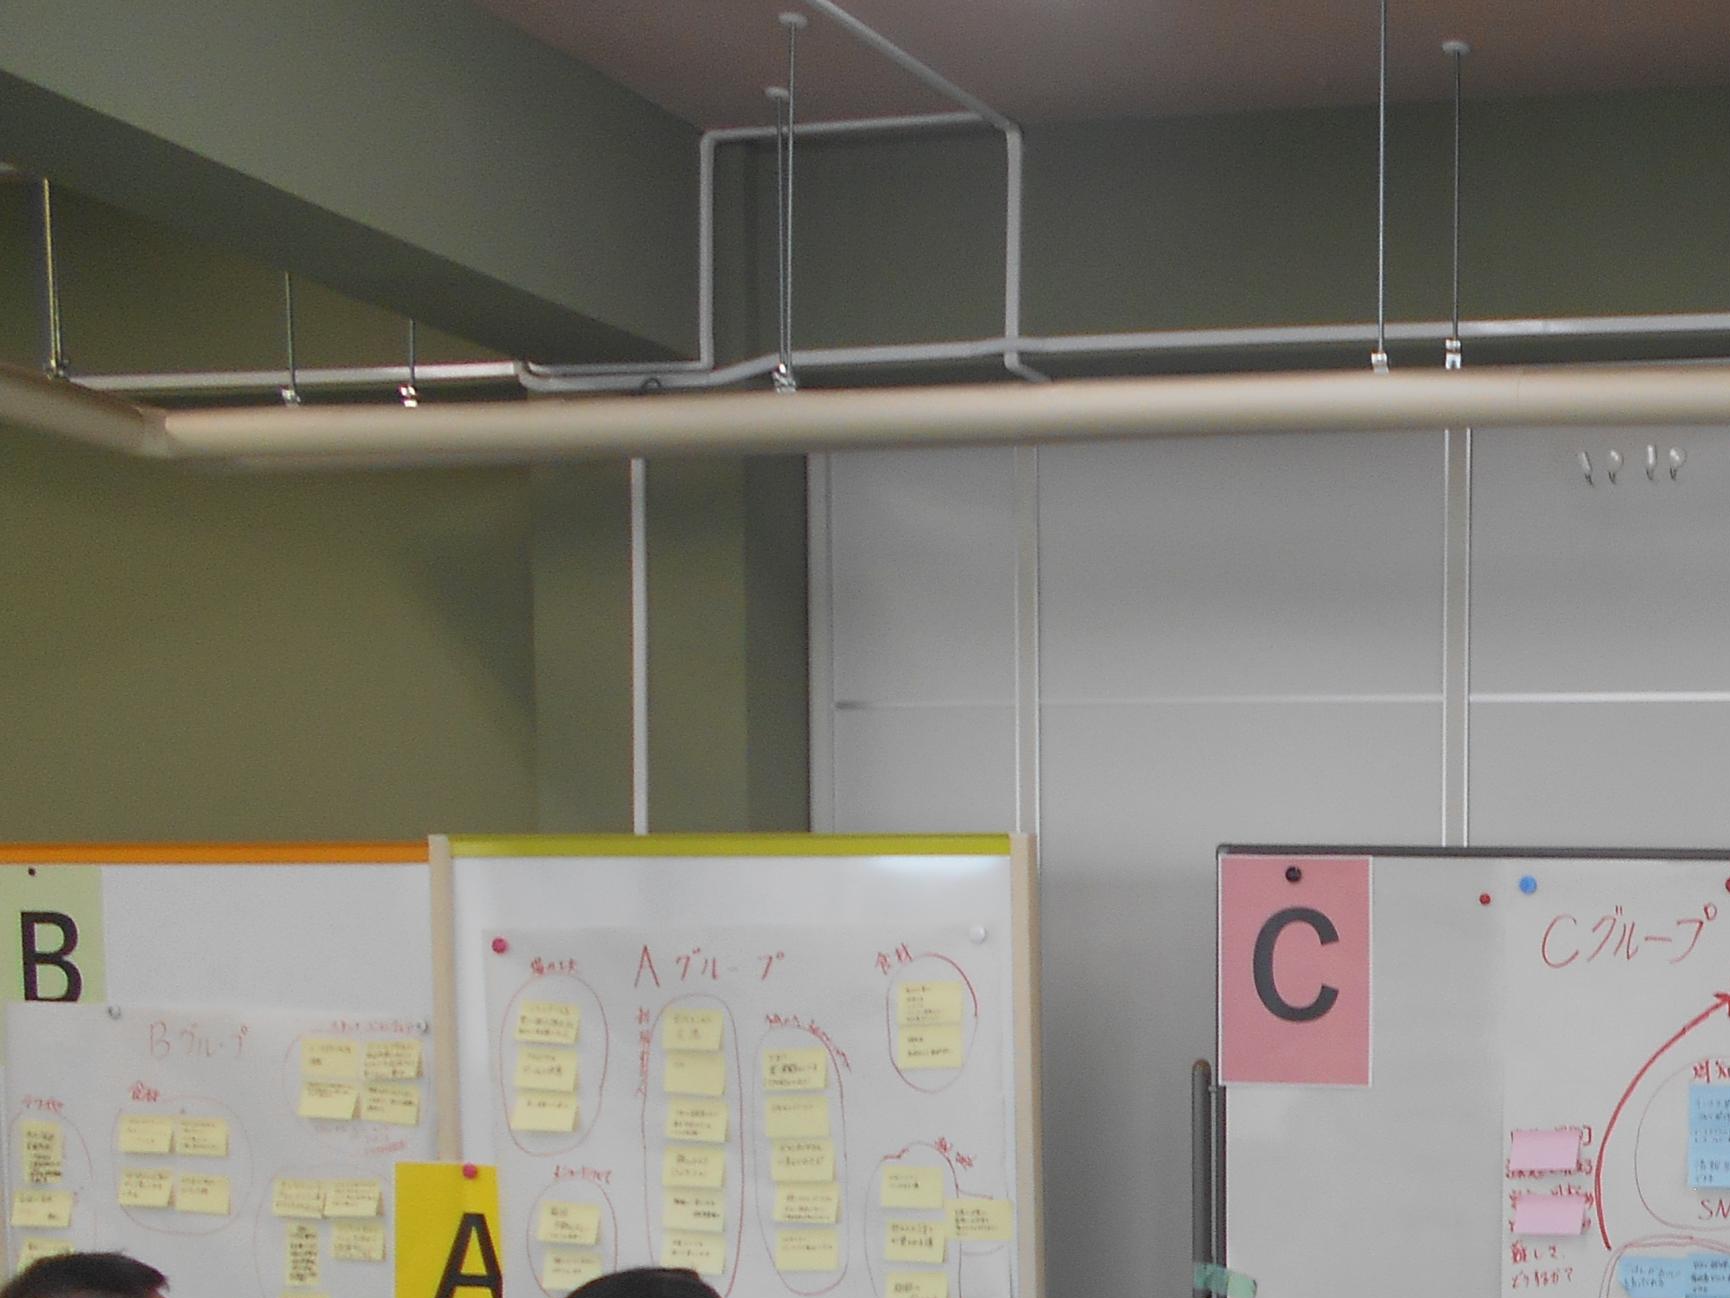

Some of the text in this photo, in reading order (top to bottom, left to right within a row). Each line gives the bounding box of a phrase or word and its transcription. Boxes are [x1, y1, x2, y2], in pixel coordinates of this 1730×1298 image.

[20, 911, 83, 1002] B
[1252, 907, 1340, 1023] C
[1542, 902, 1718, 969] Cグループ
